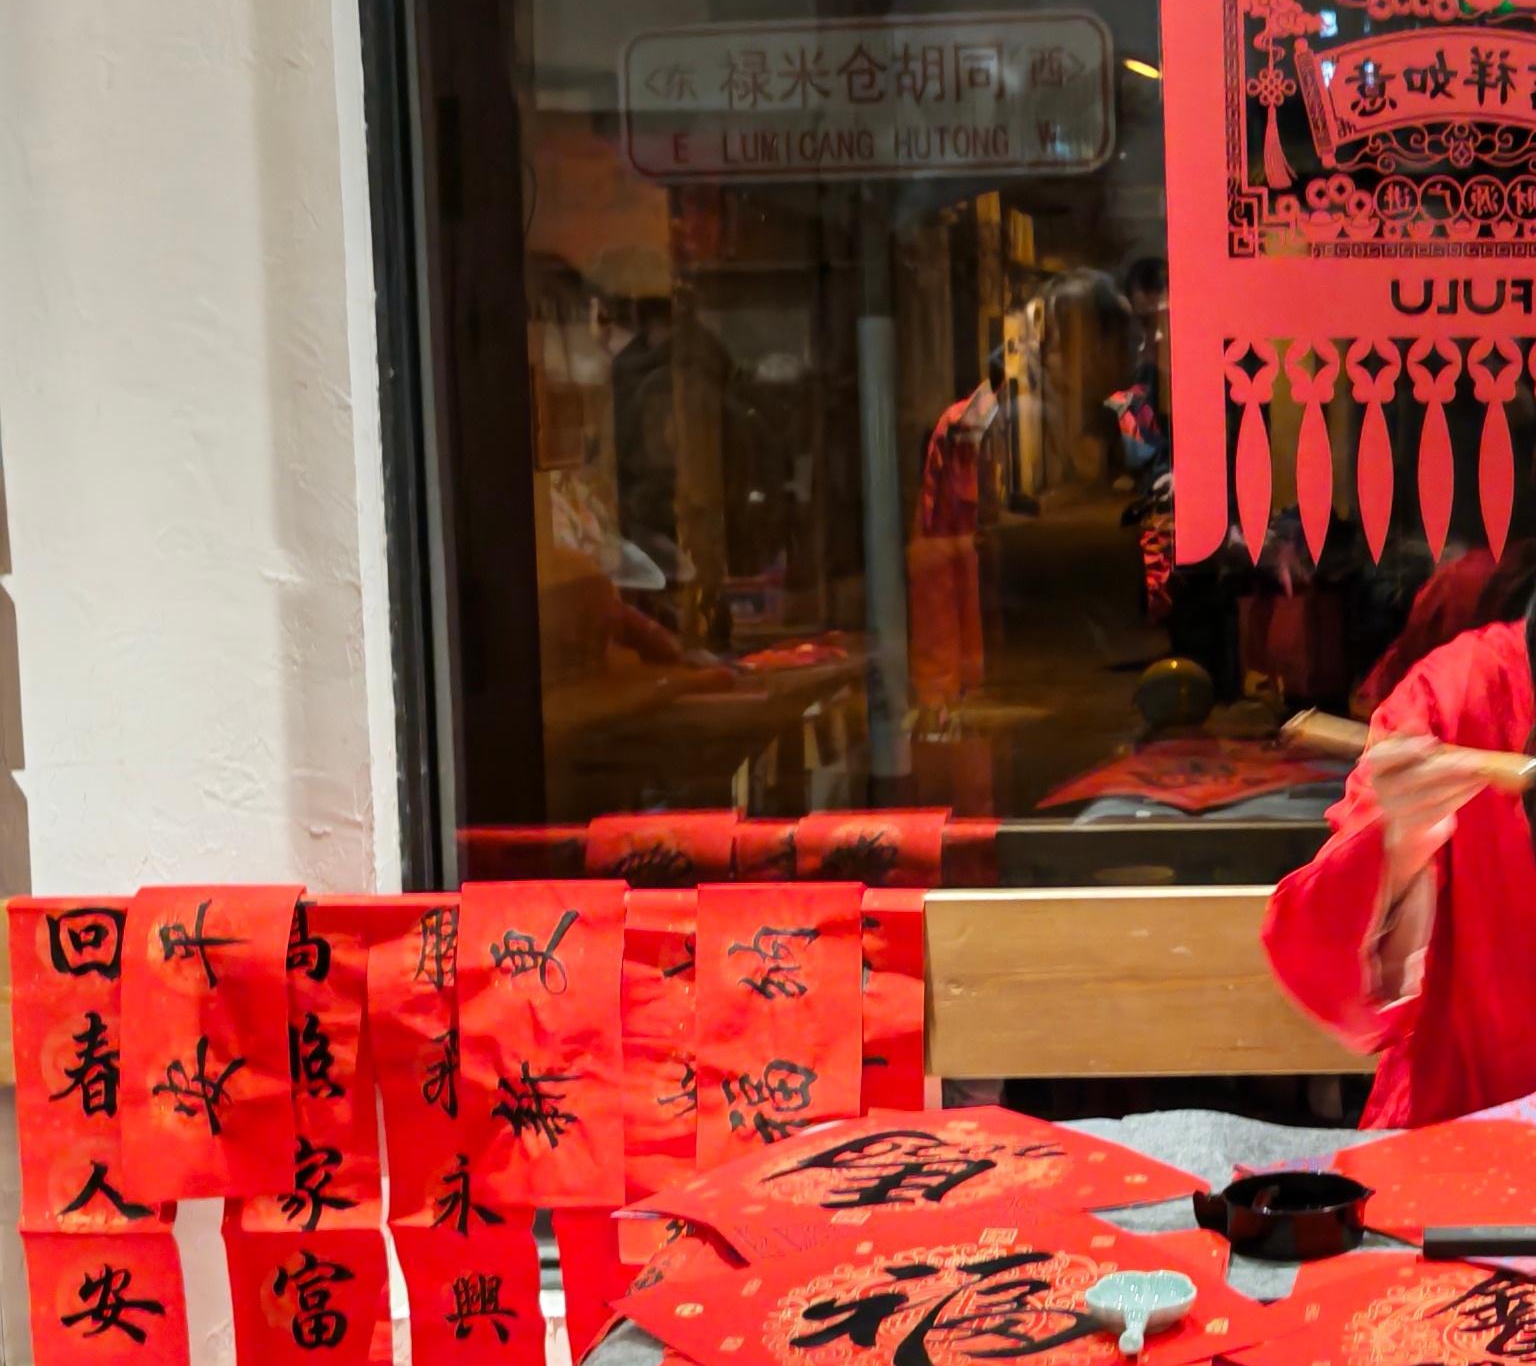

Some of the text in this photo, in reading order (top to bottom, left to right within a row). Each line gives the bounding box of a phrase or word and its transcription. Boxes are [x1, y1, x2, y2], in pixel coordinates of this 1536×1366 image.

[718, 42, 1004, 110] 禄米仓胡同
[893, 122, 1009, 159] HUTONG
